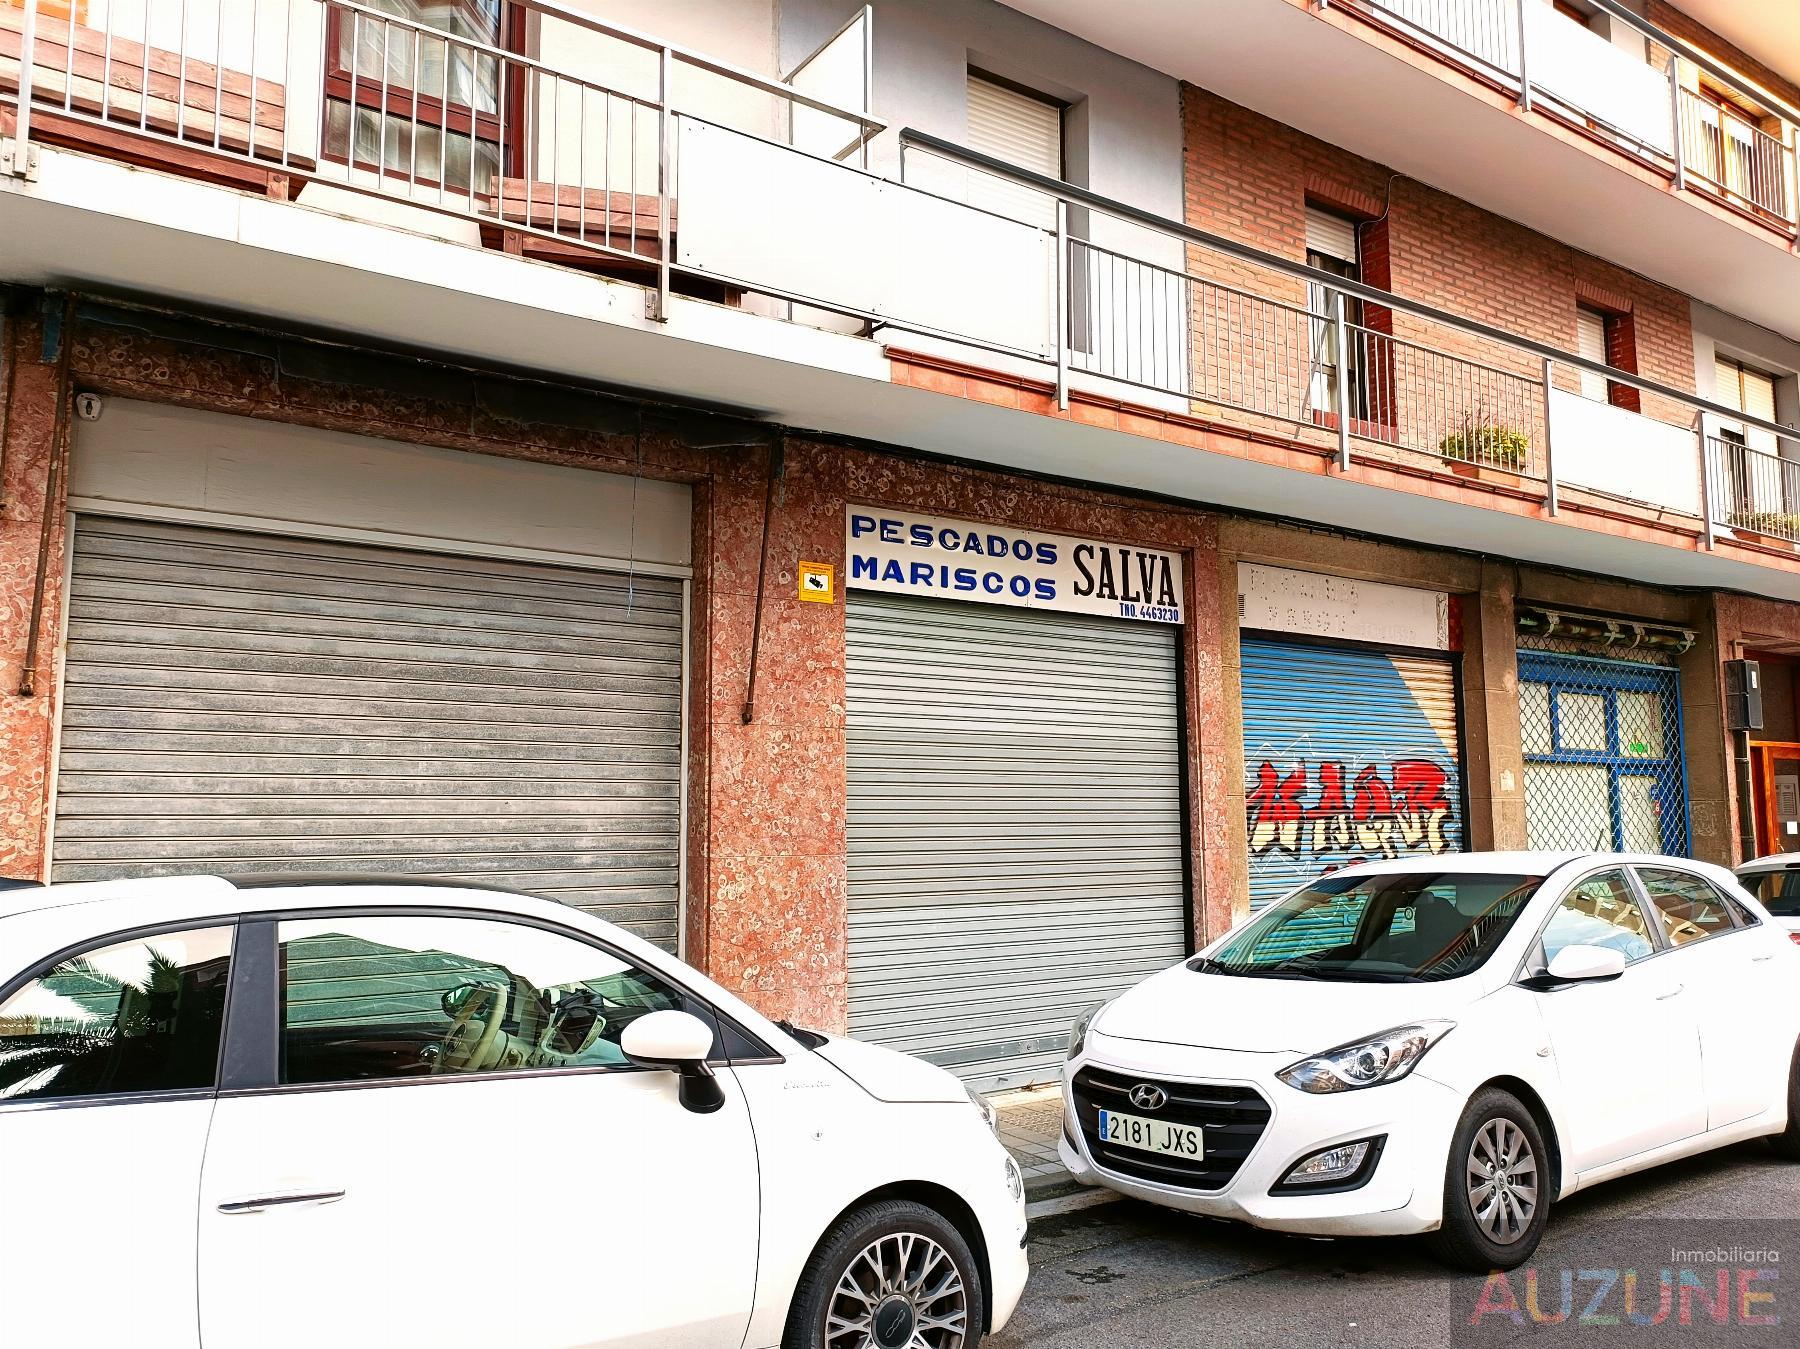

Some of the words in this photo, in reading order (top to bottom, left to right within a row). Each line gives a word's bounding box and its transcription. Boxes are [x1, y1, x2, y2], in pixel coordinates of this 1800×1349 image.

[851, 514, 1058, 565] PESCADOS
[852, 554, 1057, 600] MARISCOS
[1073, 544, 1179, 607] SALVA
[1140, 606, 1179, 622] 4463230
[1110, 1116, 1152, 1146] 2181
[1161, 1126, 1198, 1154] JXS
